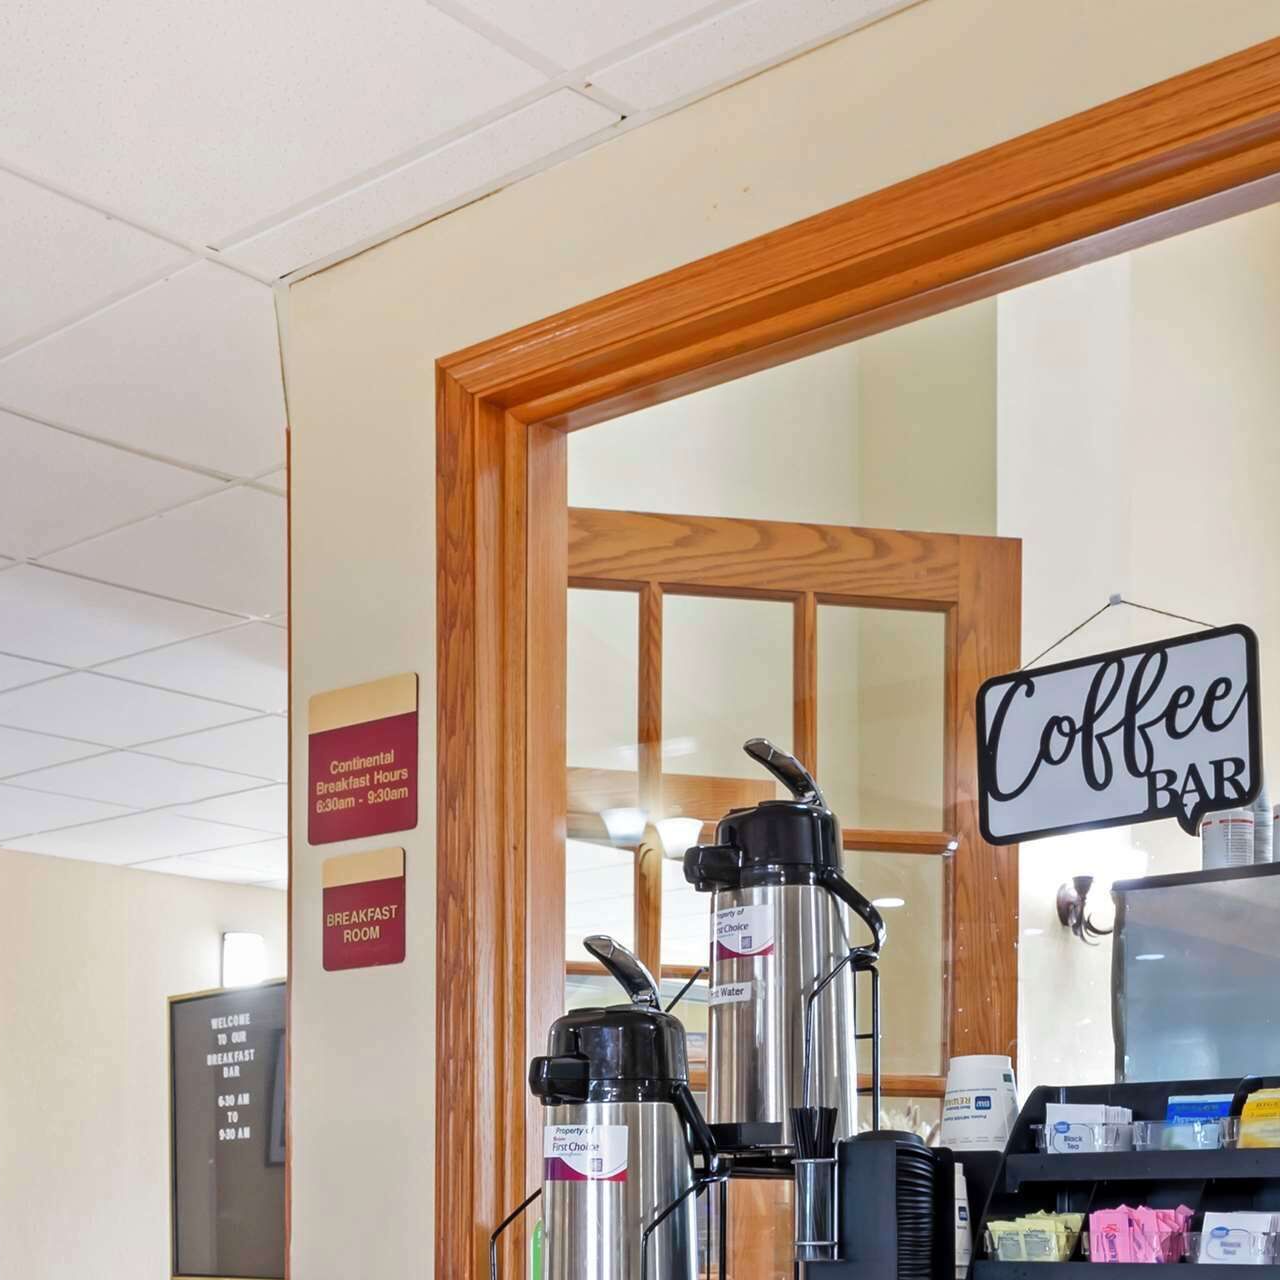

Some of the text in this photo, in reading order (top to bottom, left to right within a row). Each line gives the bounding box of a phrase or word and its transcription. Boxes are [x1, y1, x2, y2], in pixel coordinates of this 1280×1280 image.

[987, 648, 1248, 803] Coffee
[329, 749, 394, 775] Continental
[316, 768, 409, 796] Breakfast Hours
[1146, 756, 1247, 814] BAR
[316, 797, 356, 814] 6:30am
[367, 787, 409, 805] 9:30am
[326, 904, 398, 928] BREAKFAST
[343, 925, 380, 943] ROOM
[720, 986, 745, 997] Water
[210, 1012, 251, 1030] WELCOME
[217, 1033, 228, 1046] TO
[206, 1048, 256, 1067] BREAKFAST
[223, 1065, 240, 1079] BAR
[237, 1093, 251, 1106] AM
[227, 1111, 239, 1123] TO
[237, 1126, 251, 1139] AM
[555, 1126, 585, 1136] Property
[552, 1142, 568, 1153] First
